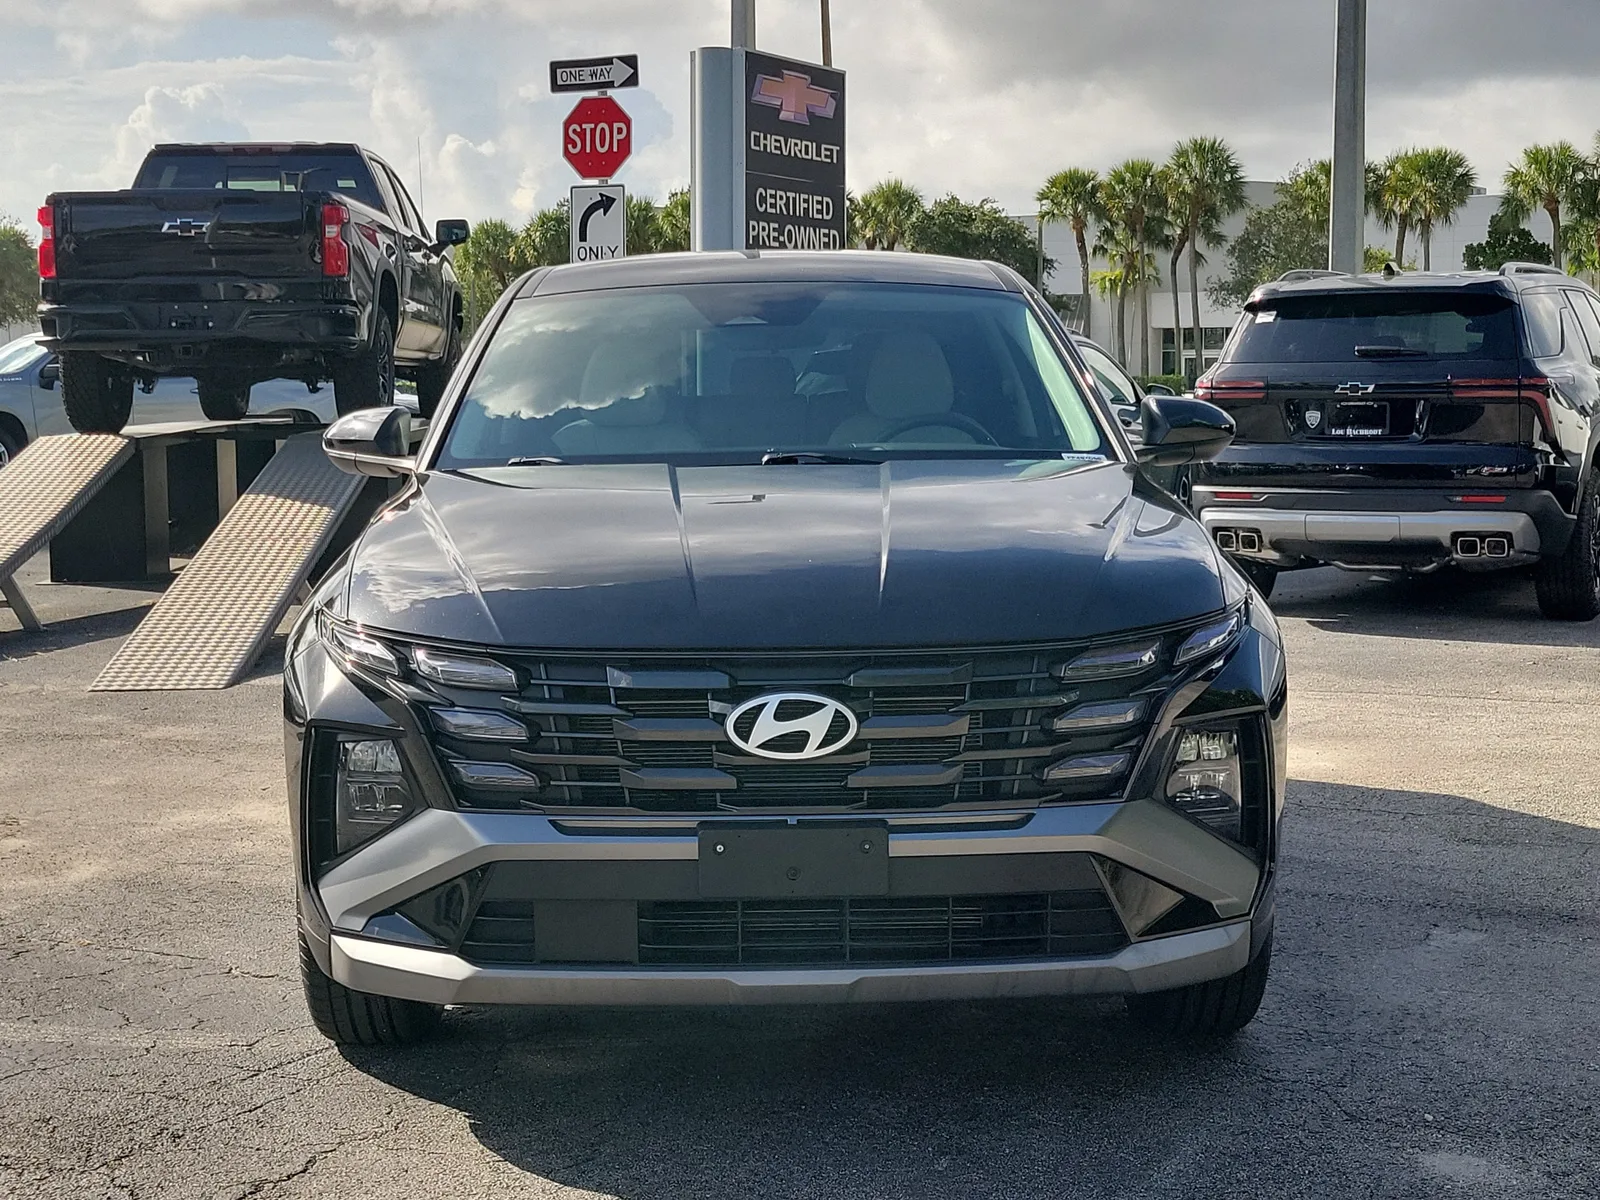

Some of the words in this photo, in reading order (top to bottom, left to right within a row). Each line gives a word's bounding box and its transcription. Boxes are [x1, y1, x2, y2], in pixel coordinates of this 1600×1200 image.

[560, 69, 585, 83] ONE
[589, 66, 613, 81] WAY
[567, 122, 627, 154] STOP
[750, 131, 840, 164] CHEVROLET
[756, 187, 833, 220] CERTIFIED
[749, 220, 840, 249] PRE-OWNED
